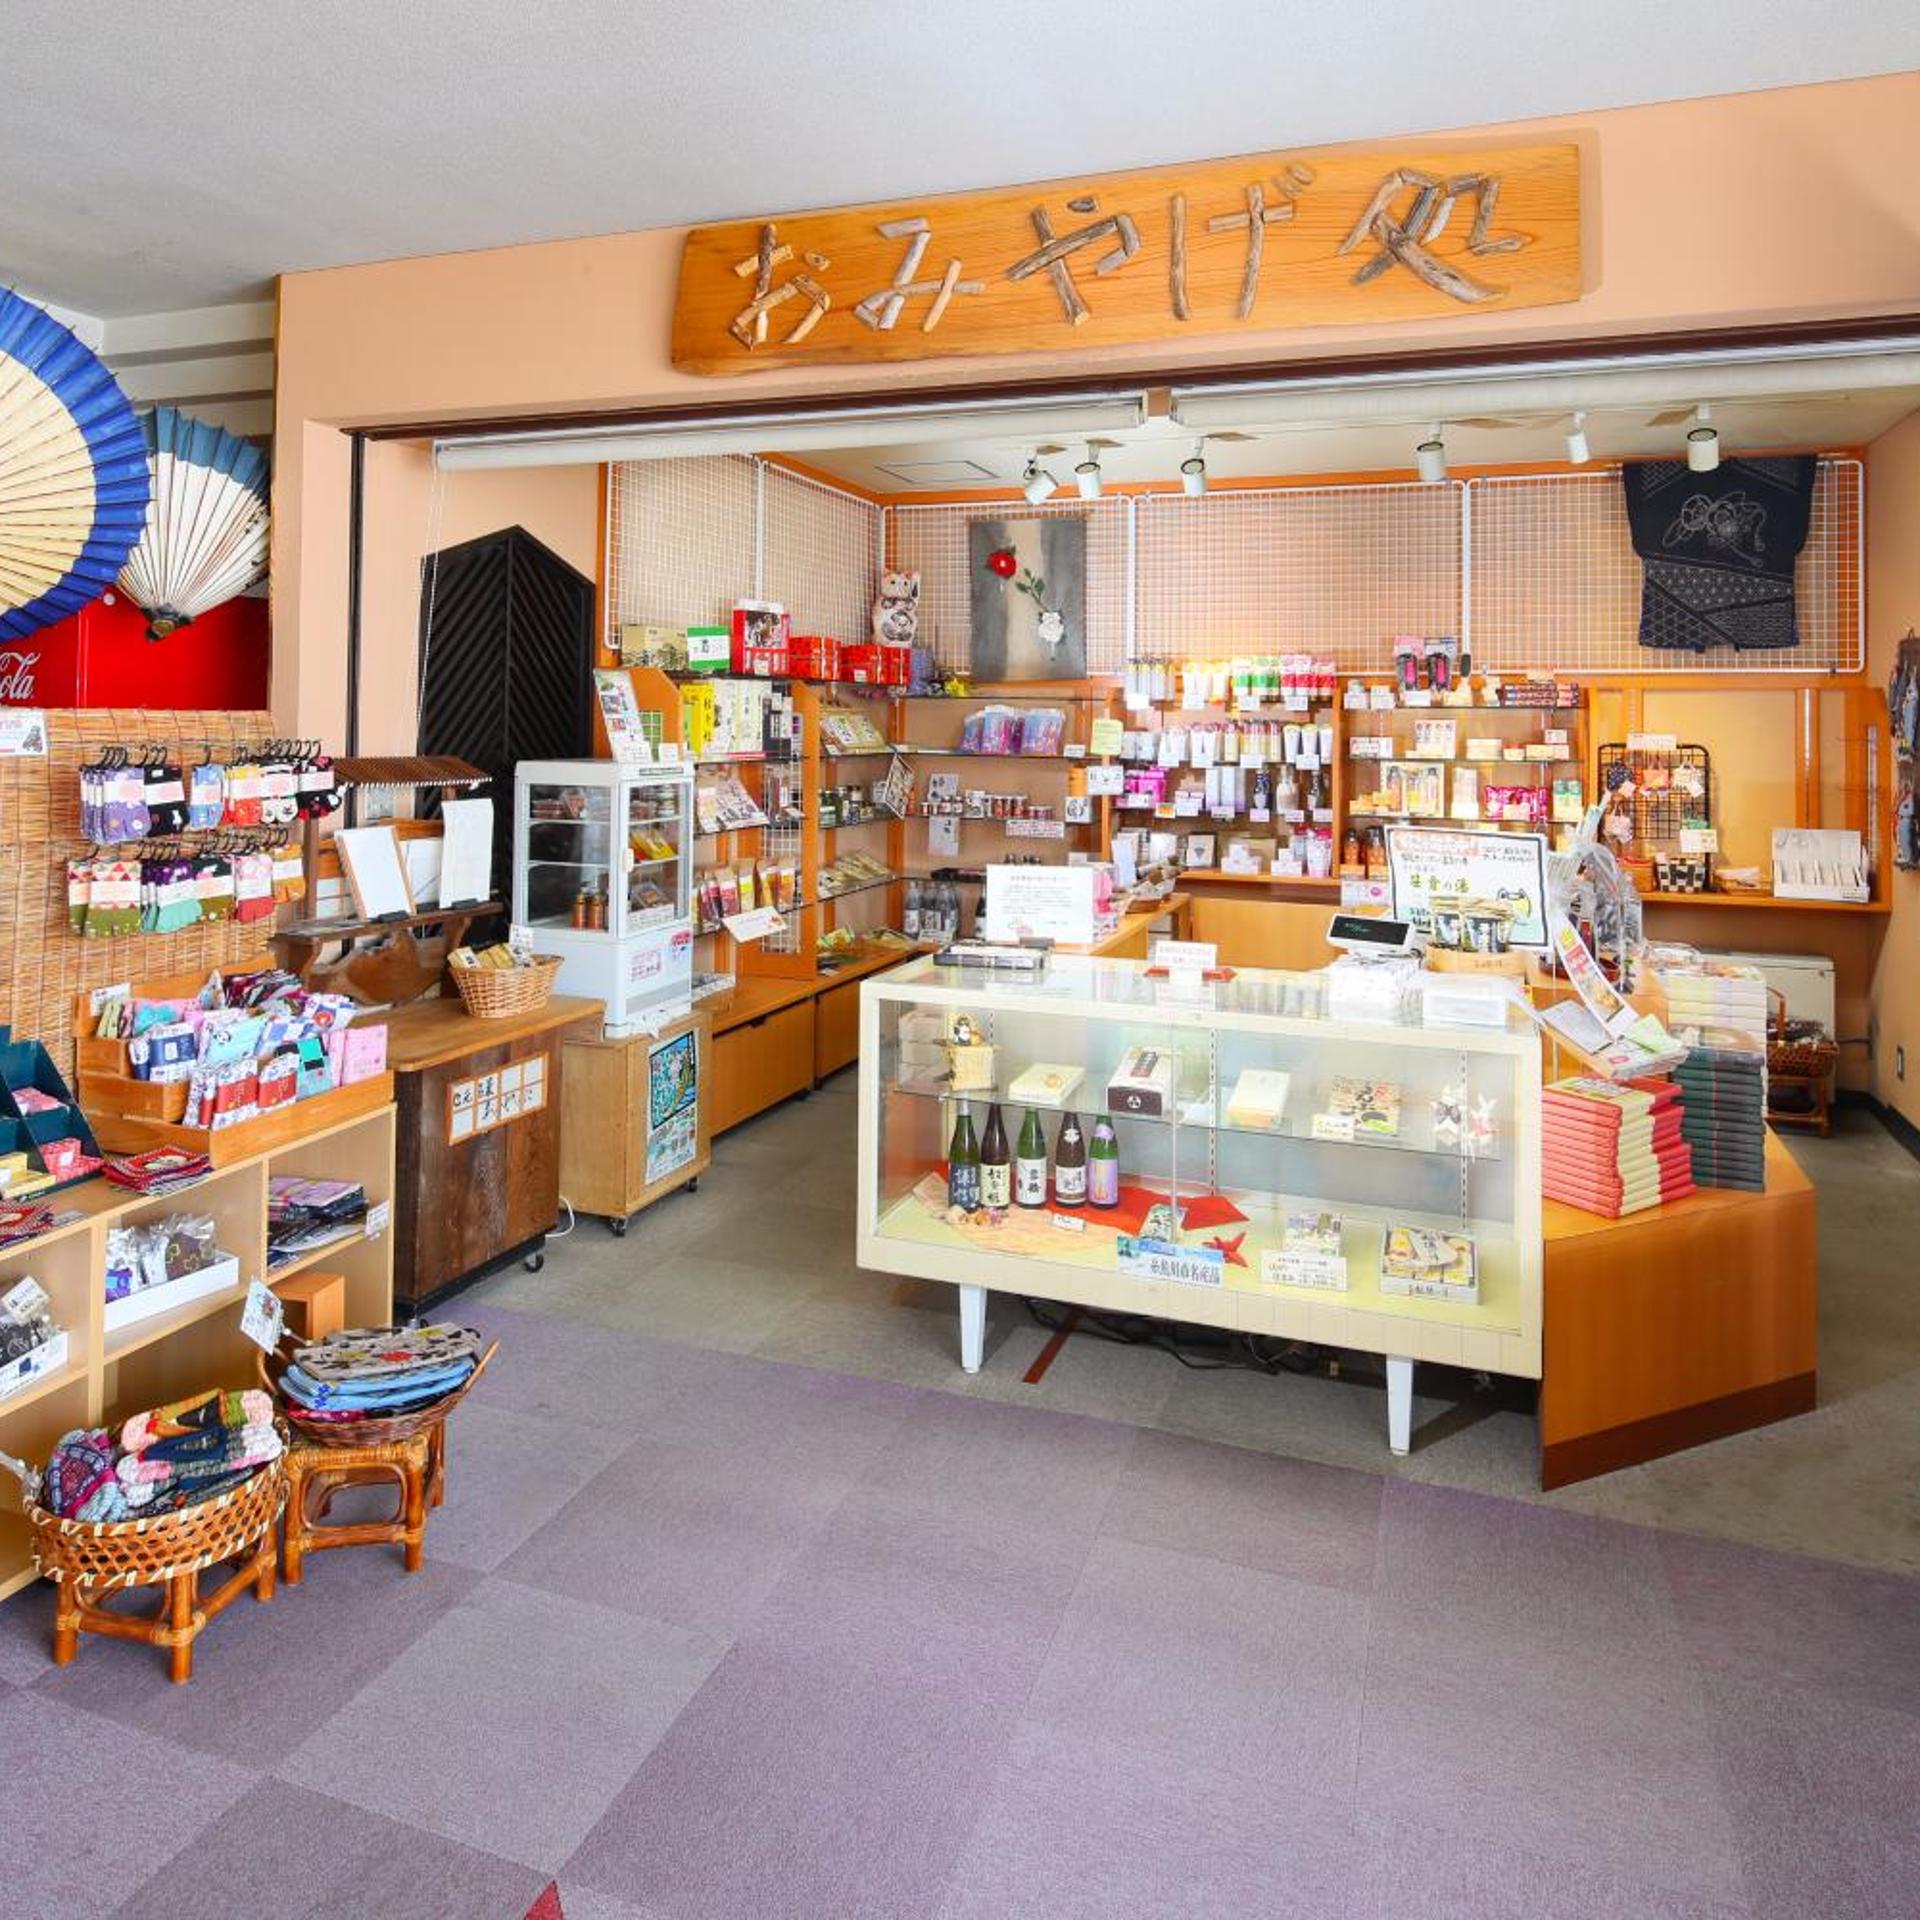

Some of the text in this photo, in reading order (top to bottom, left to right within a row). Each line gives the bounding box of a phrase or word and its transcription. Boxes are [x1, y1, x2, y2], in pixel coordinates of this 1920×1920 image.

[729, 164, 1525, 350] おみやげ処
